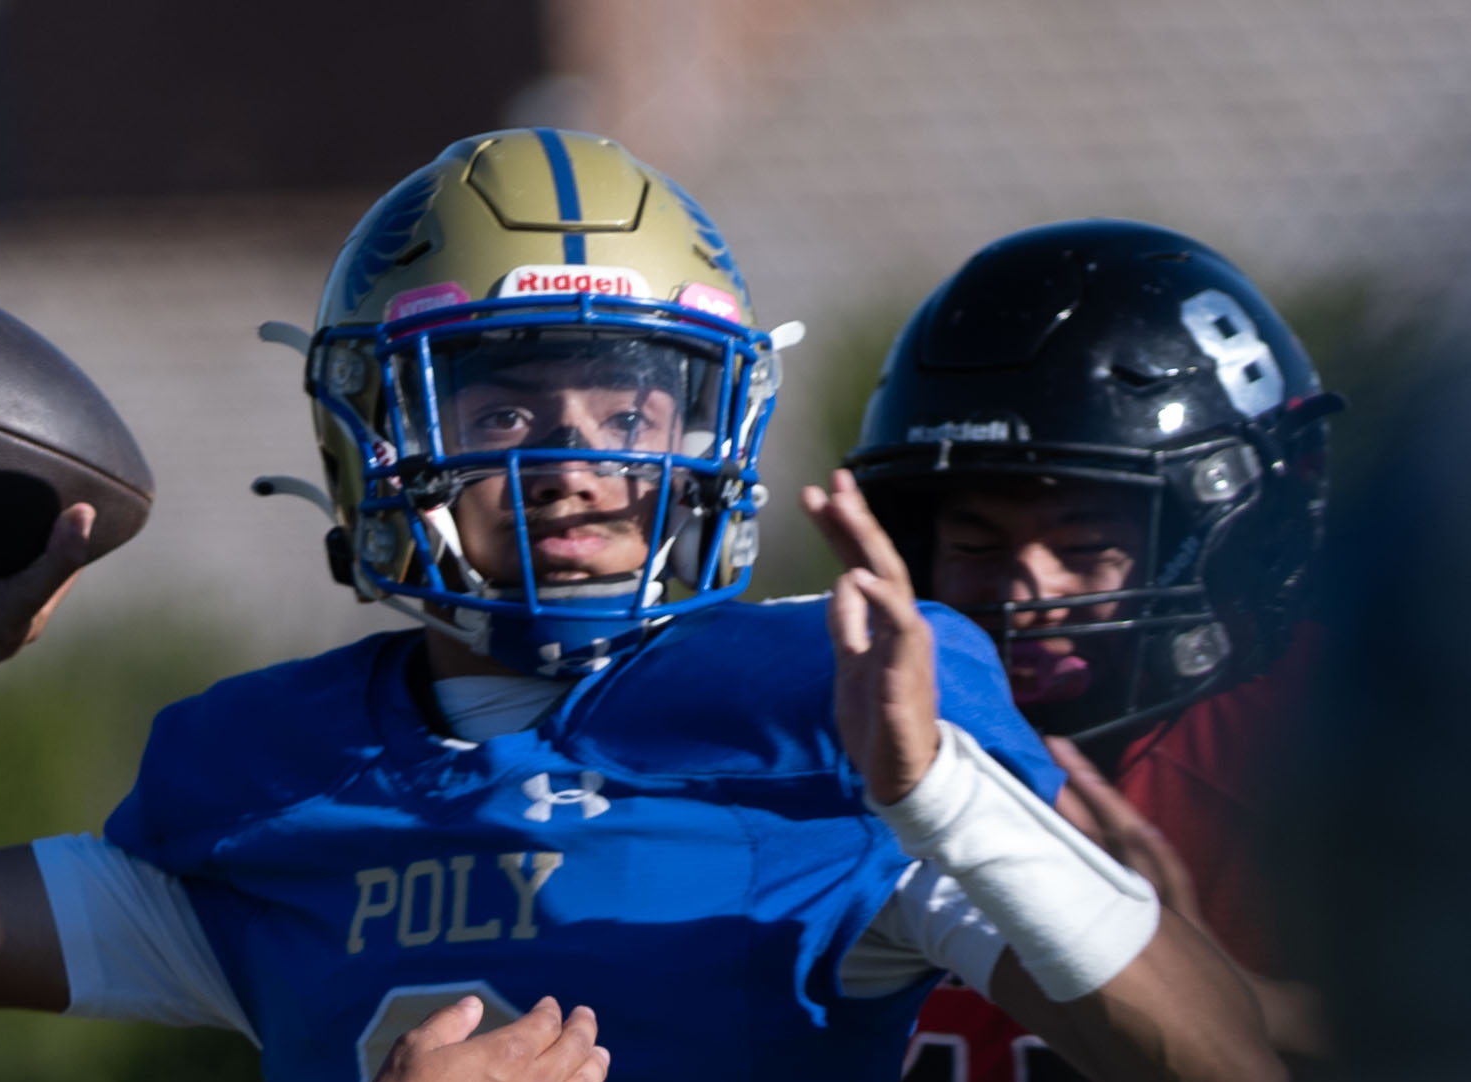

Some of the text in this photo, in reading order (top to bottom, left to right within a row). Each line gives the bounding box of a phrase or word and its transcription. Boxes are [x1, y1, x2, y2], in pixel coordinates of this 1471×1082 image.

[517, 272, 633, 297] Riddell
[1181, 289, 1284, 419] 8
[347, 851, 564, 954] POLY
